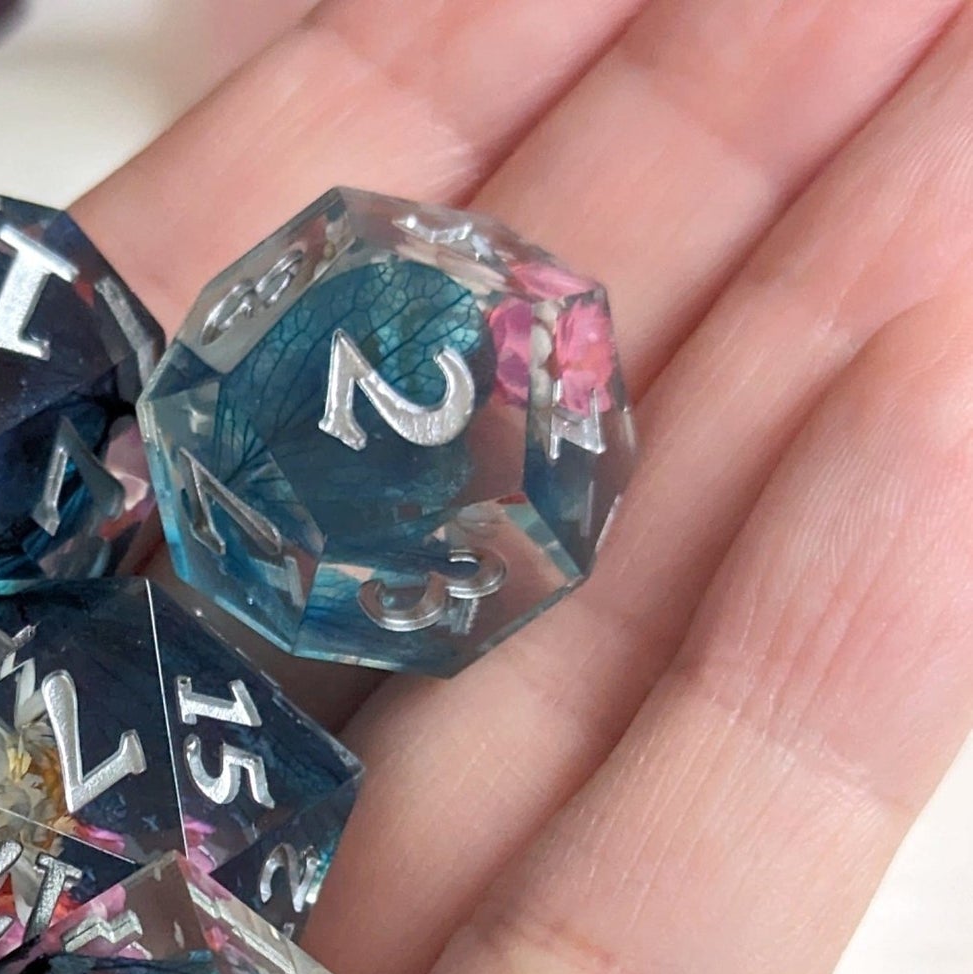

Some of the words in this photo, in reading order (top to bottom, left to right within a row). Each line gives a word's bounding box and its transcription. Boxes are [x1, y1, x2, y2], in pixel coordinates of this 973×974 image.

[317, 327, 476, 451] 2
[41, 668, 148, 814] 7
[173, 675, 277, 811] 15
